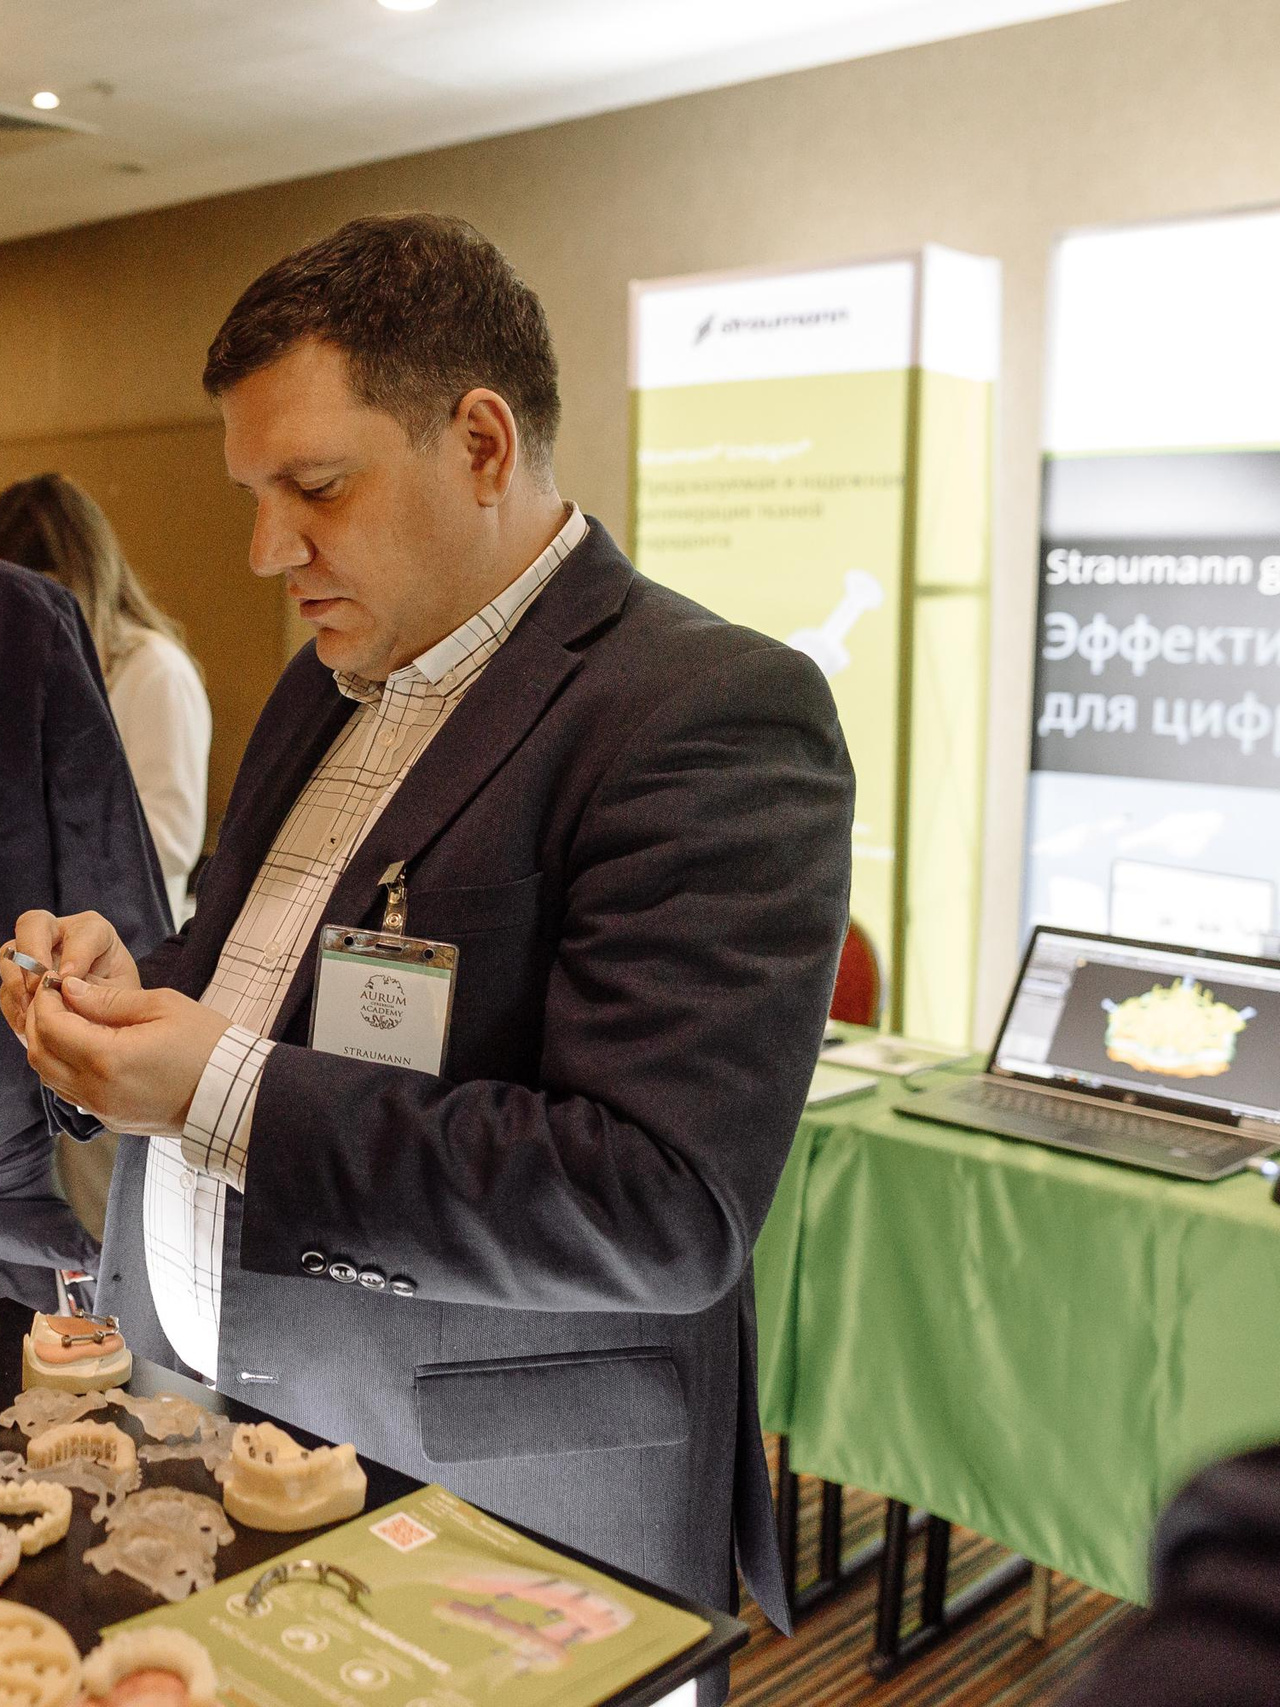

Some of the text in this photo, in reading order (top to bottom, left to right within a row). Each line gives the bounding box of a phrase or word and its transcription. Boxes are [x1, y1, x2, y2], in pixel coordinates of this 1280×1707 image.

[1044, 548, 1255, 587] Straumann
[1037, 691, 1137, 740] для
[360, 990, 406, 1006] AURUM
[361, 1005, 404, 1017] ACADEMY
[344, 1046, 411, 1065] STRAUMANN
